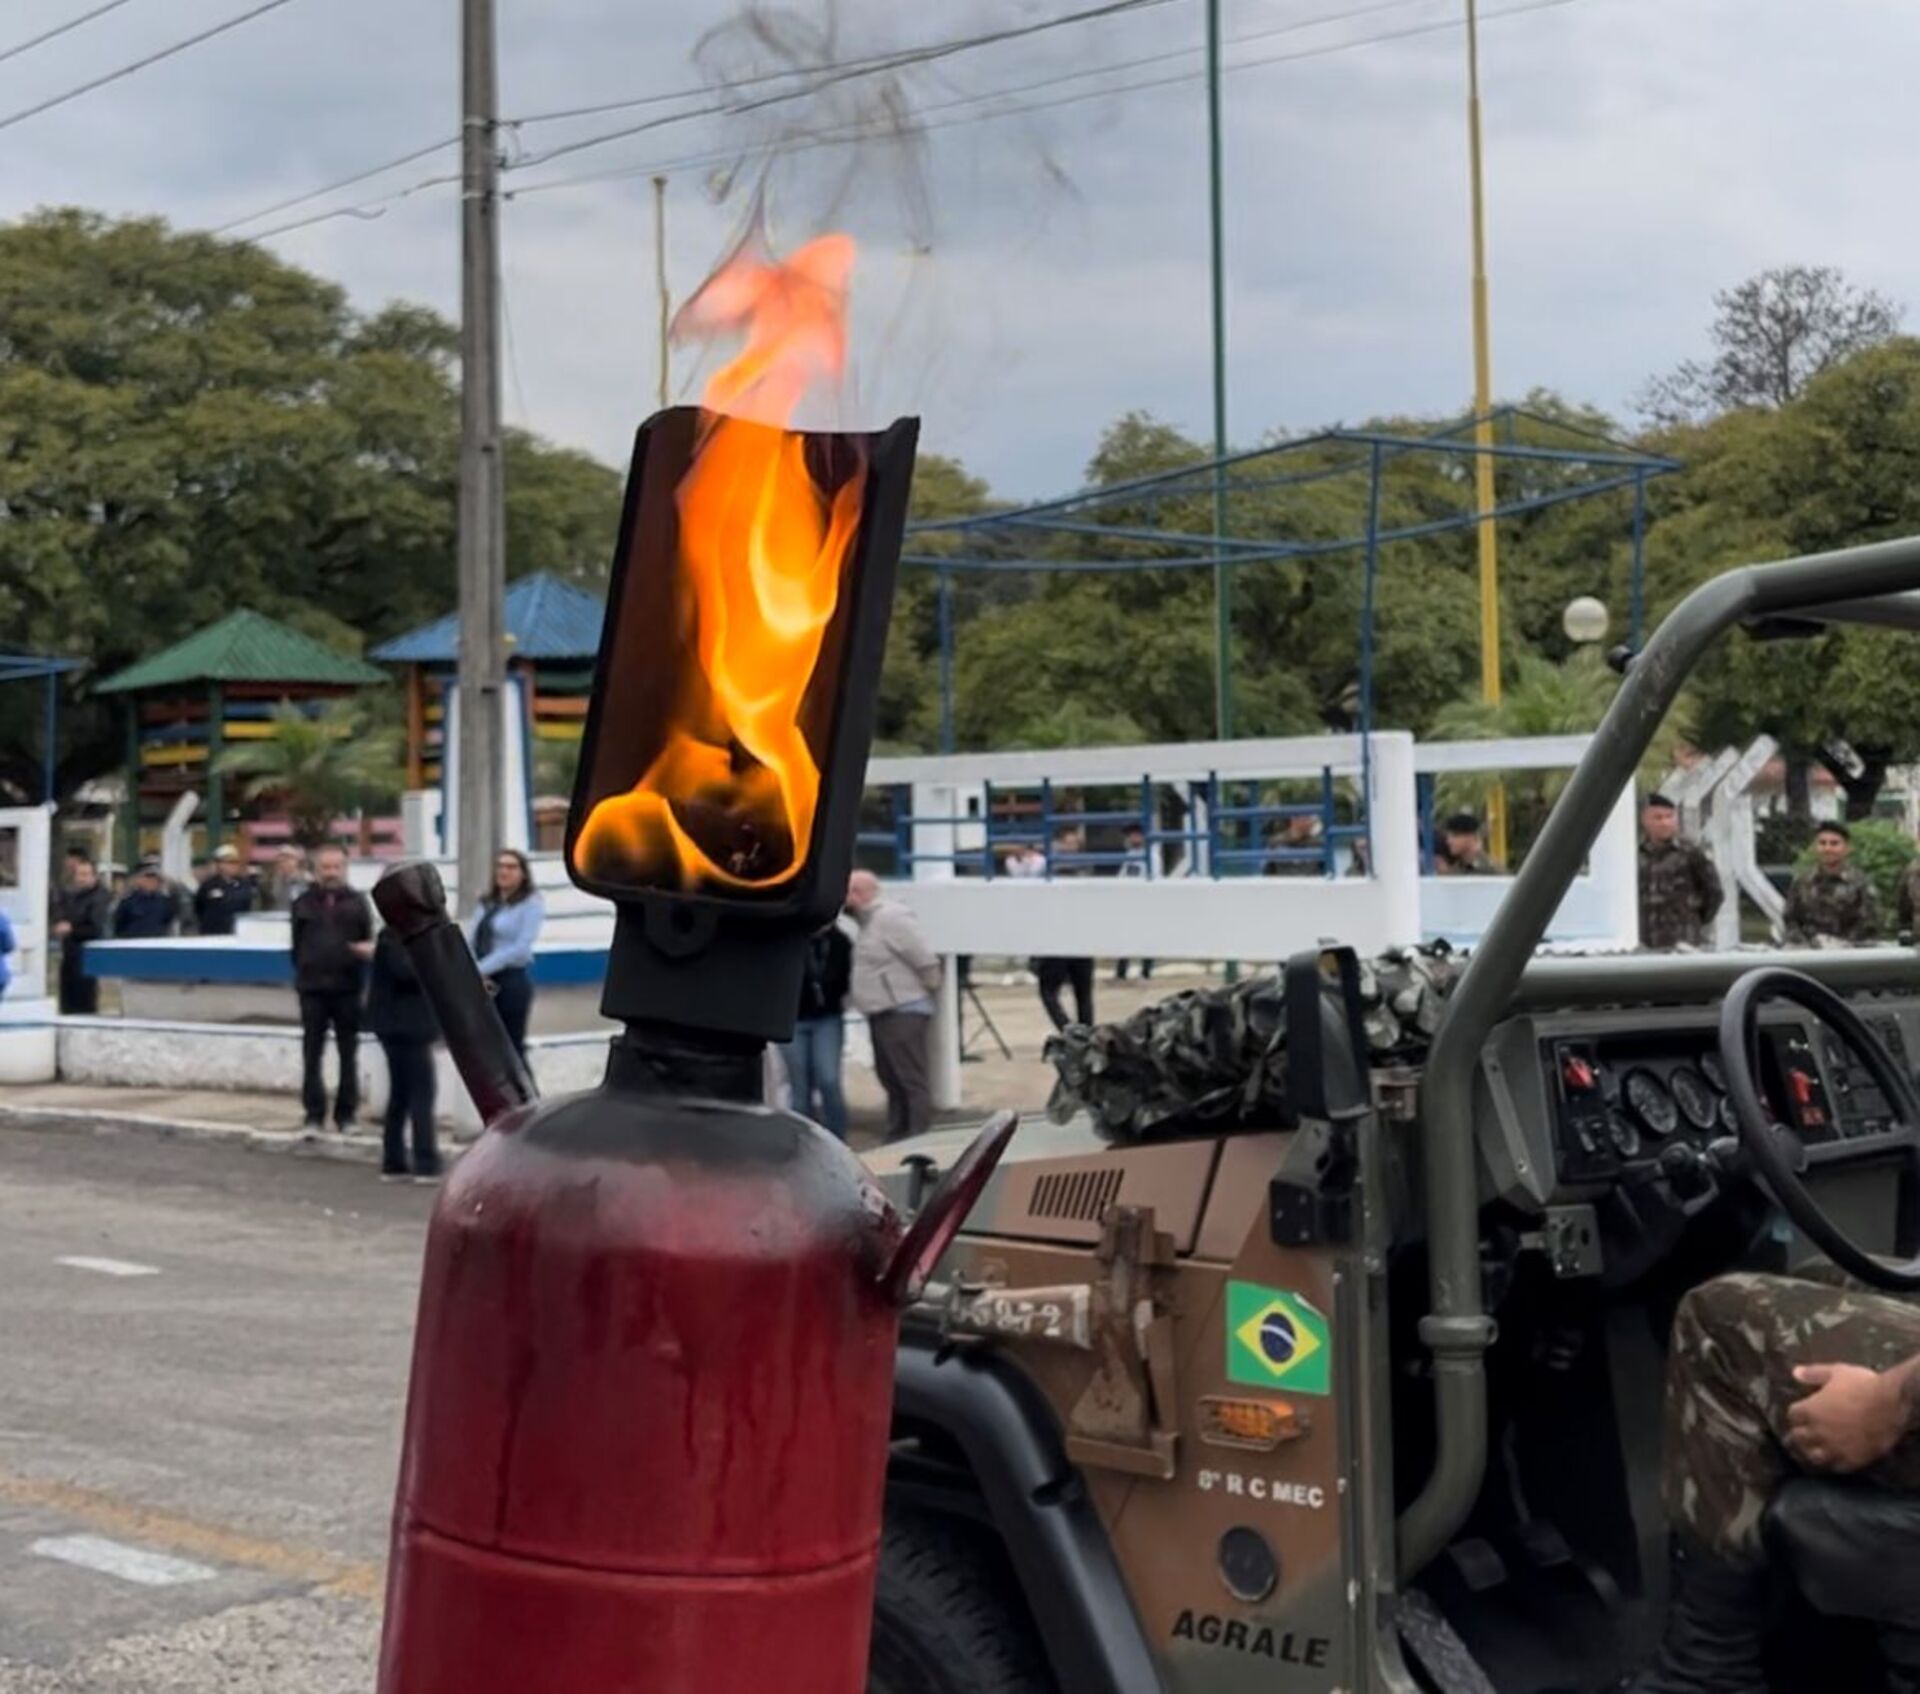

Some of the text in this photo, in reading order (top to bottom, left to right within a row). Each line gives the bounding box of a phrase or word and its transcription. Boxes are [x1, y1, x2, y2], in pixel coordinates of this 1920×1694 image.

[1226, 1473, 1244, 1496] R
[1248, 1477, 1267, 1499] C
[1272, 1480, 1325, 1509] MEC
[1171, 1608, 1330, 1669] AGRALE
